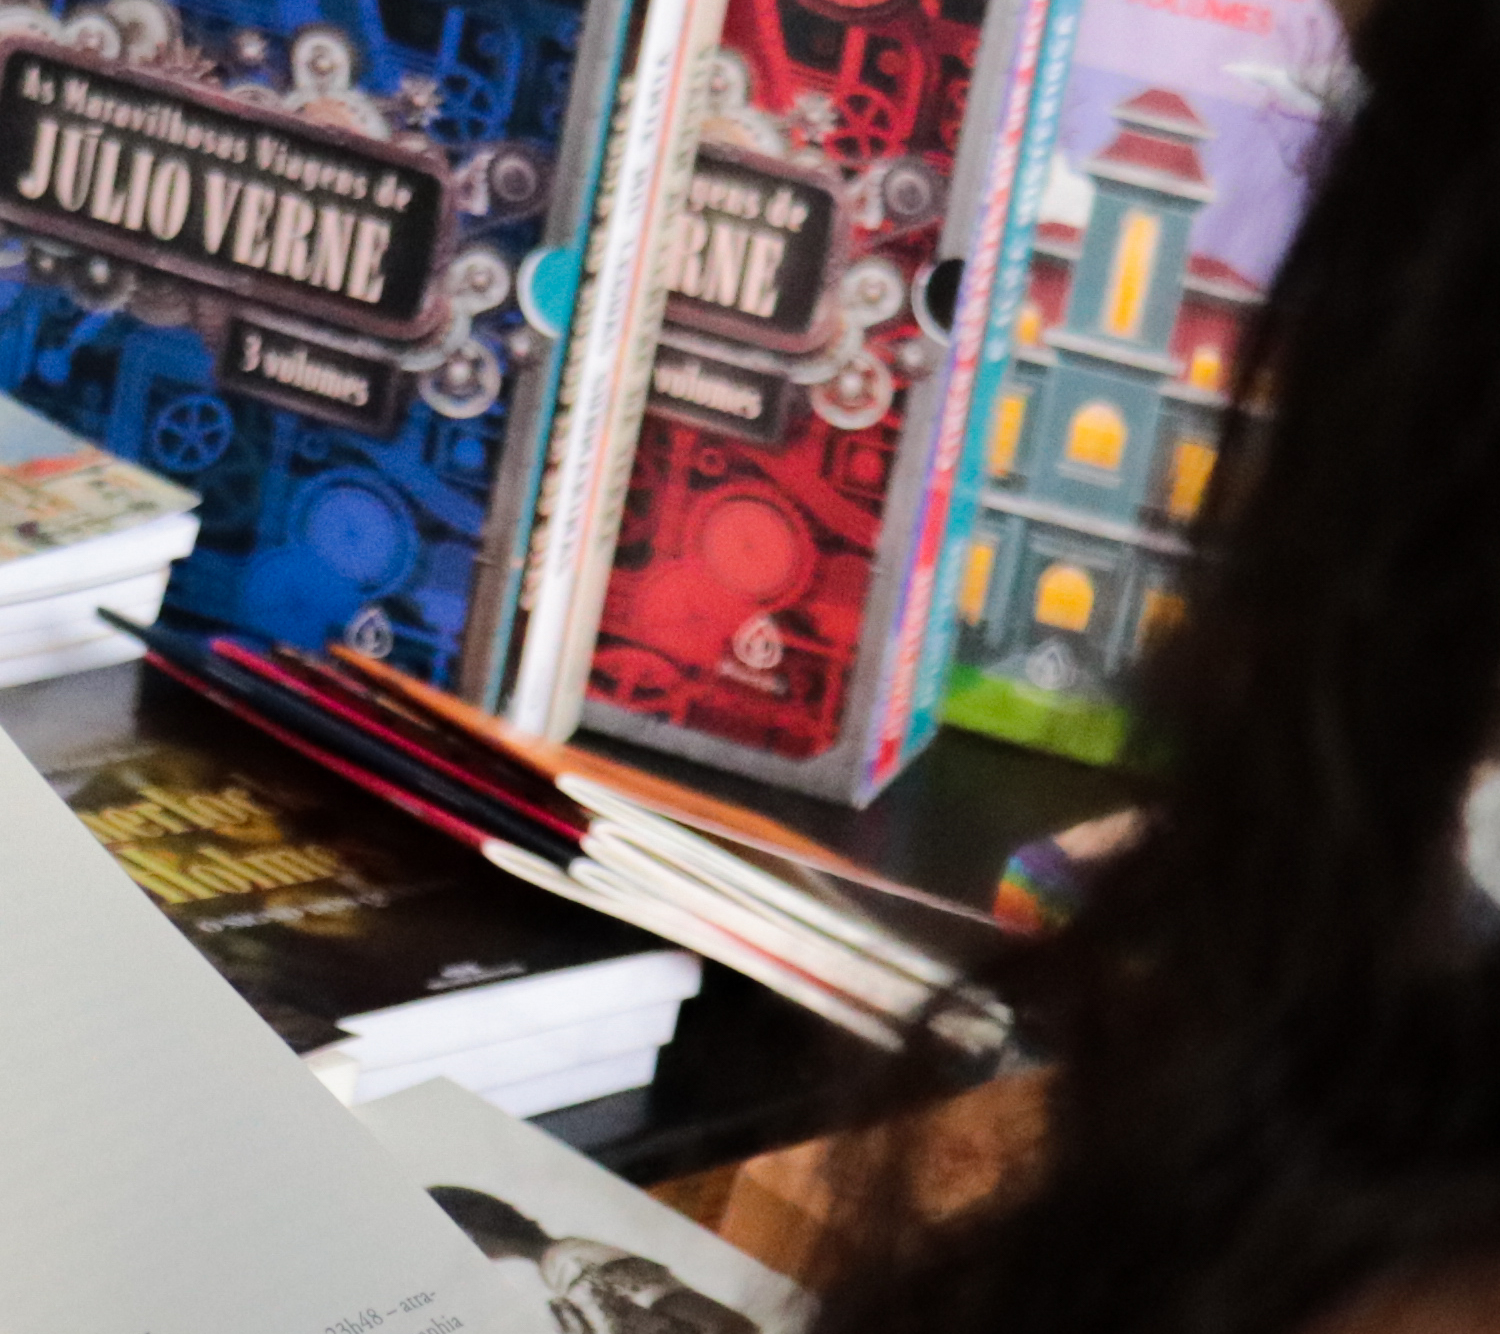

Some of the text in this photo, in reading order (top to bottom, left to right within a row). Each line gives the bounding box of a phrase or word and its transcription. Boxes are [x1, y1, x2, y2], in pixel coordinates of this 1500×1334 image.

[62, 77, 249, 165] Maravilhosas
[254, 137, 369, 200] Viagens
[373, 170, 413, 214] de
[18, 119, 394, 305] JÚLIO VERNE
[765, 188, 810, 232] de
[261, 341, 370, 407] volumes
[399, 1292, 441, 1312] atra-
